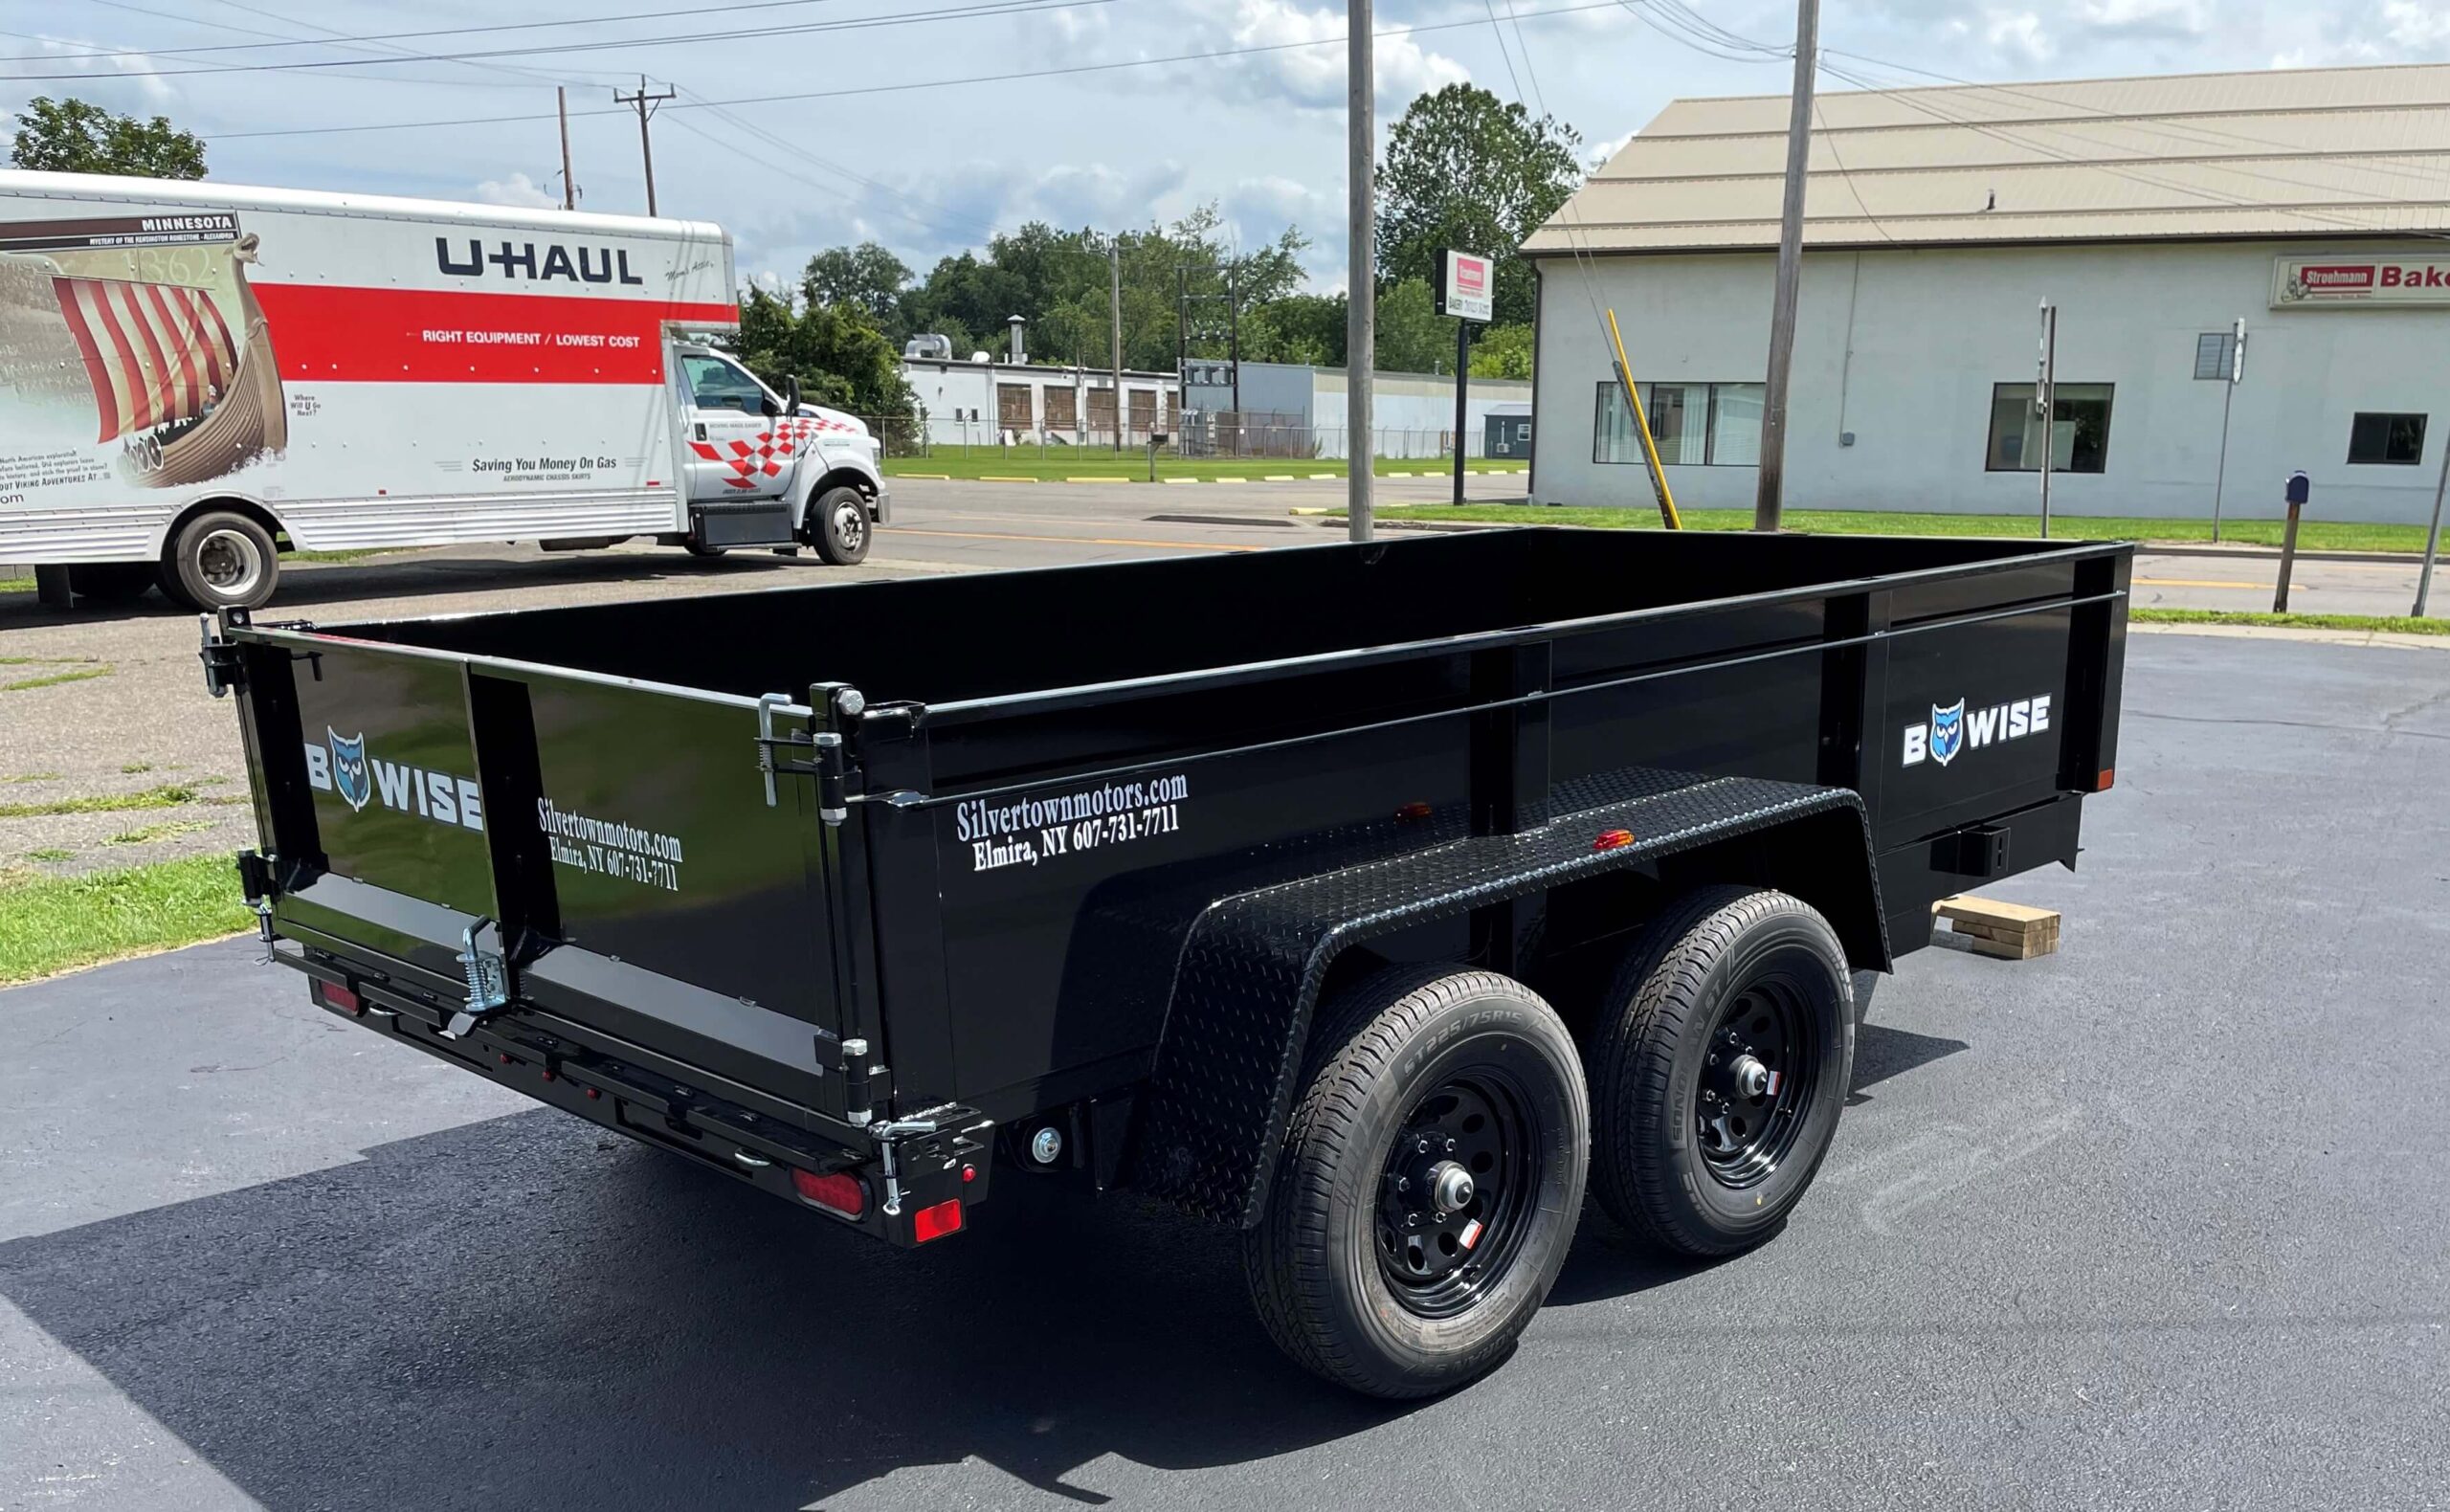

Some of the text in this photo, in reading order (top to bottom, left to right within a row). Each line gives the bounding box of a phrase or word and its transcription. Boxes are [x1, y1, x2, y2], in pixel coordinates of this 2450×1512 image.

[142, 216, 233, 232] MINNESOTA
[90, 236, 115, 246] MYSTERY
[435, 237, 643, 285] U-HAUL
[422, 330, 639, 347] RIGHT EQUIPMENT / LOWEST COST
[304, 402, 311, 411] U
[516, 457, 536, 470] You
[539, 457, 576, 472] Money
[580, 456, 593, 469] On
[597, 456, 617, 469] Gas
[957, 773, 1189, 843] Silvertownmotors.com
[538, 796, 683, 863] Silvertownmotors.com
[972, 804, 1179, 872] Elmira, NY 607-731-7711
[548, 835, 679, 892] Elmira, NY 607-731-7711
